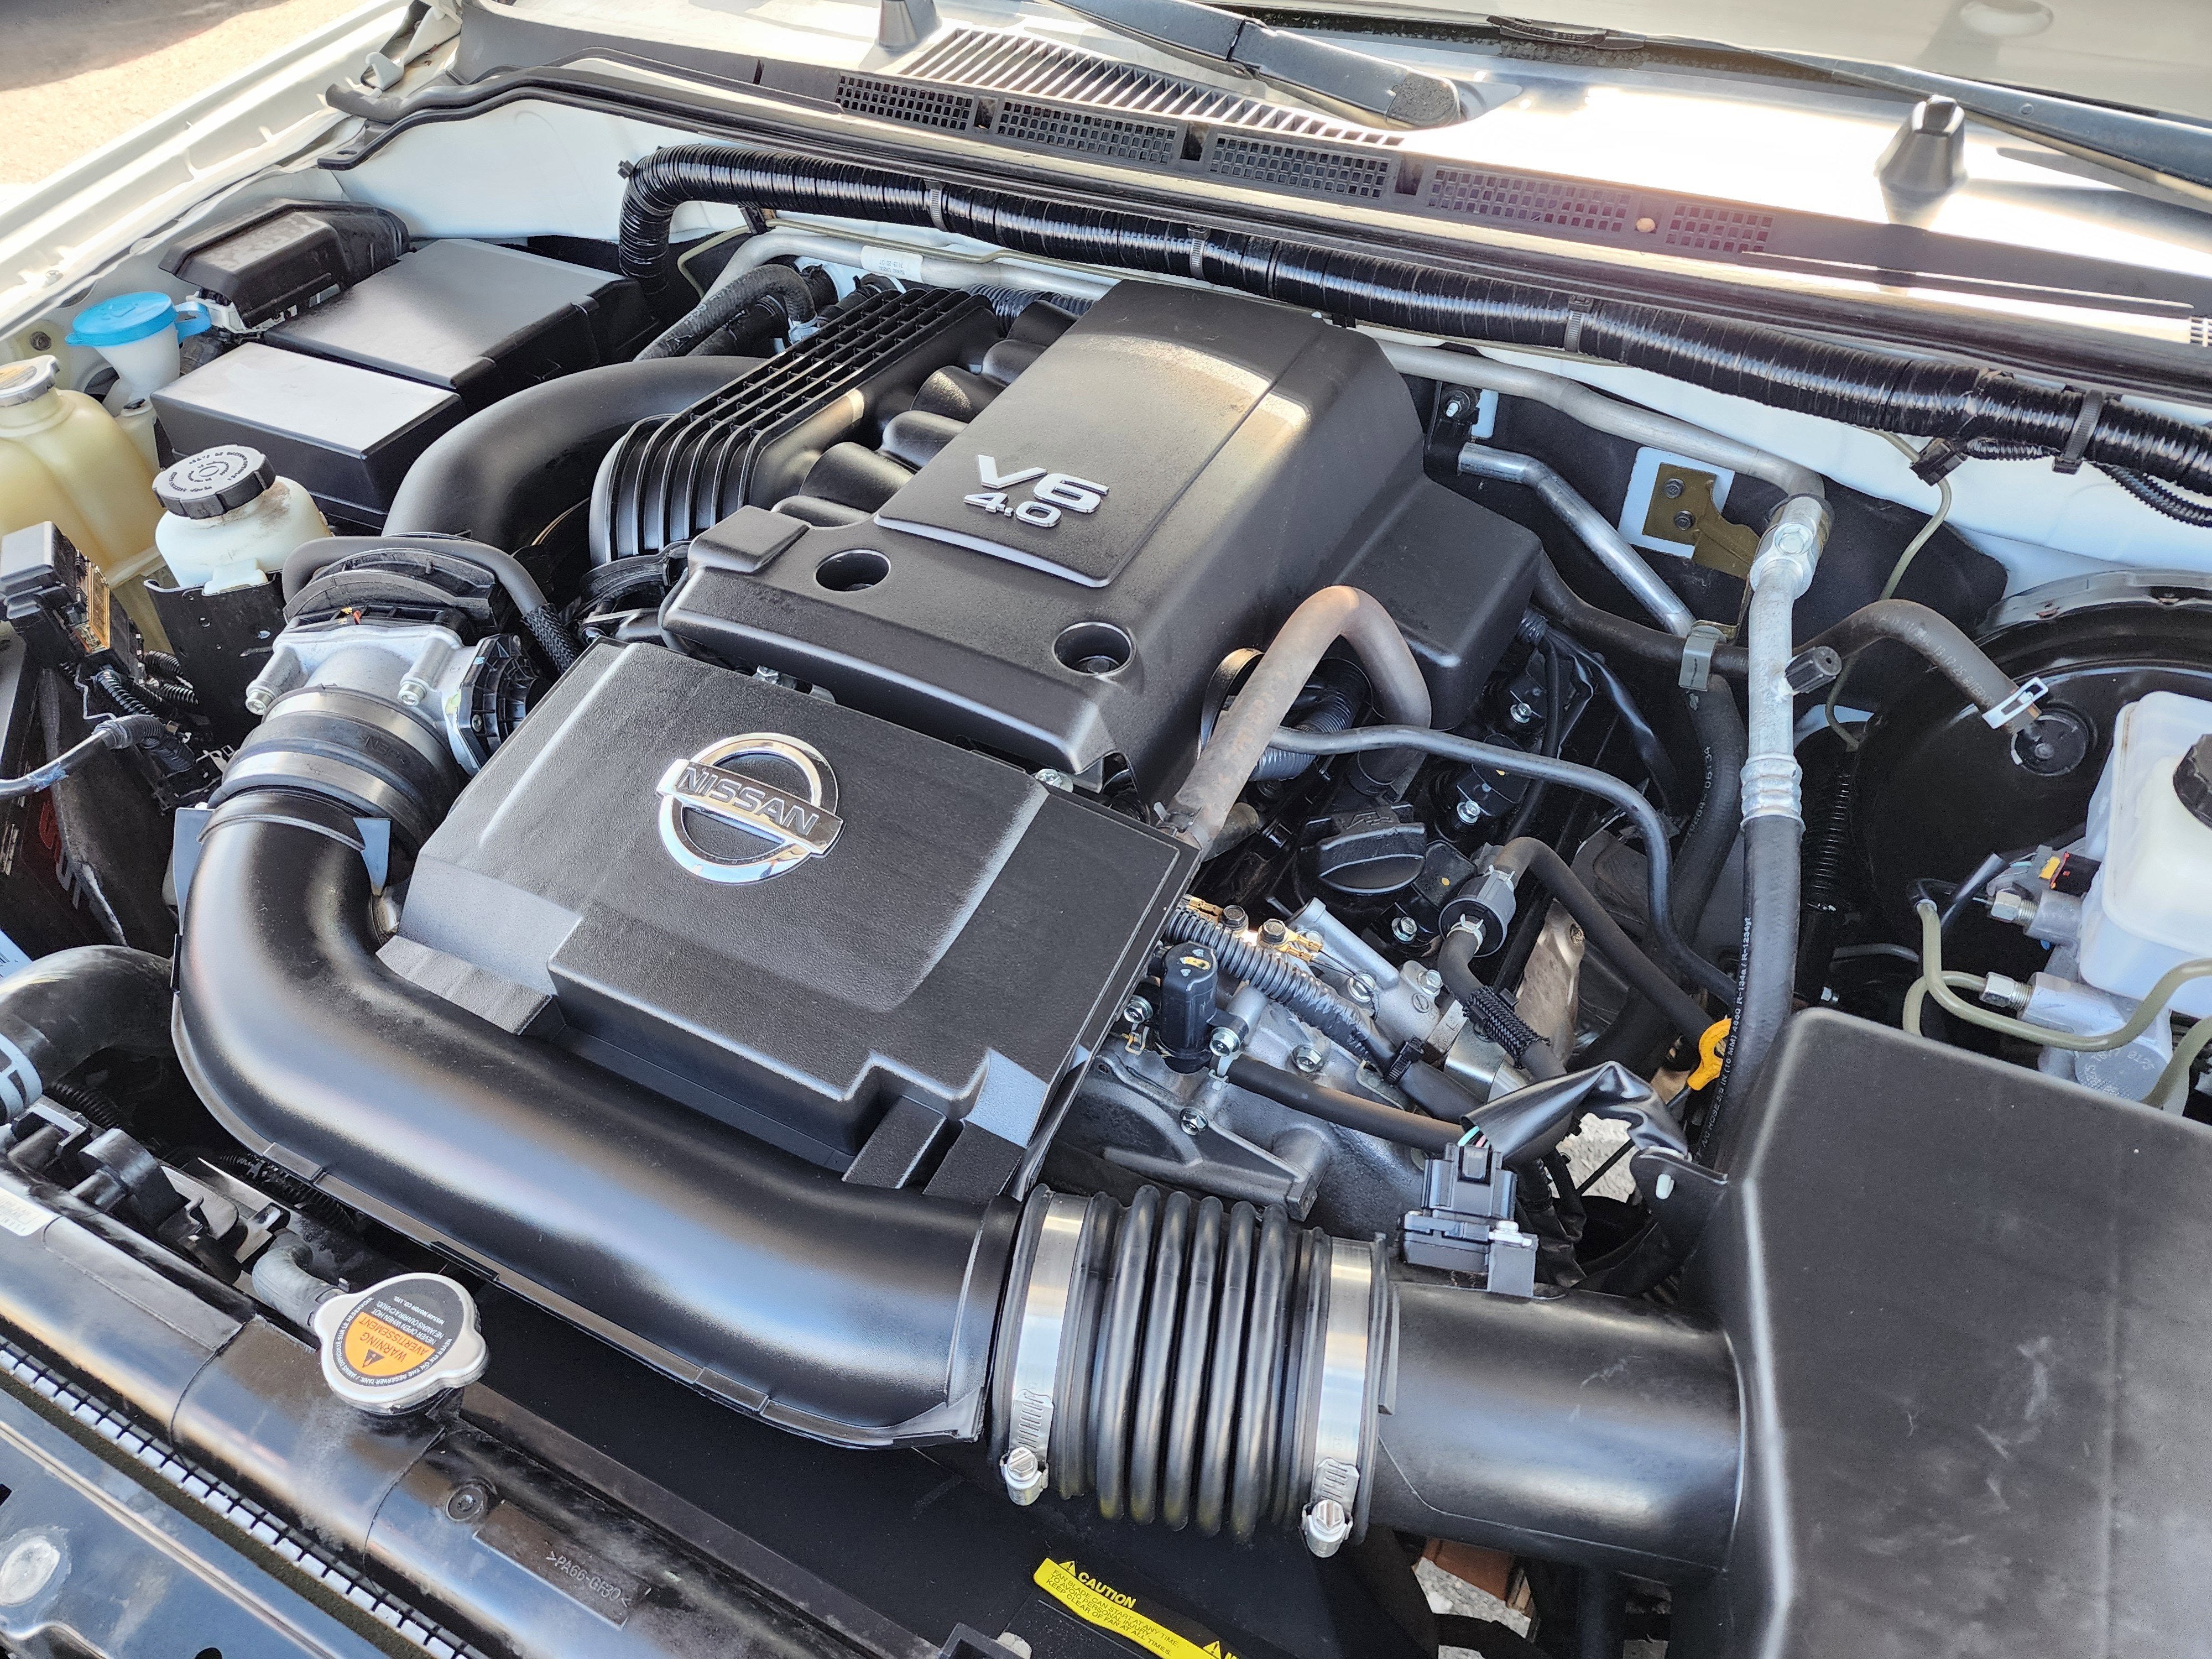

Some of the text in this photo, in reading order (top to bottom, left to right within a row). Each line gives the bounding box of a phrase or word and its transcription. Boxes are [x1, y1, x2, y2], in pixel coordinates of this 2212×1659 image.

[977, 455, 1110, 513] V6
[963, 492, 1062, 528] 4.0
[676, 766, 821, 837] NISSAN
[1706, 1102, 1720, 1130] HOSE
[1720, 1074, 1728, 1086] IN
[1728, 1035, 1738, 1055] MM)
[1735, 967, 1747, 1005] R-134a
[382, 1312, 402, 1327] WHEN
[398, 1311, 419, 1326] OUVRIR
[410, 1304, 428, 1317] MOTOR
[426, 1312, 445, 1326] NISSAN
[358, 1316, 429, 1356] AVERTISSEMENT
[359, 1331, 408, 1363] WARNING
[400, 1322, 418, 1336] OPEN
[416, 1331, 437, 1345] NEVER
[434, 1330, 444, 1339] NE
[1050, 1574, 1151, 1637] TO AVOID PERSONAL INJURY.
[1078, 1571, 1136, 1609] CAUTION
[1045, 1578, 1067, 1595] KEEP
[1065, 1594, 1091, 1614] CLEAR
[1091, 1611, 1103, 1620] OF
[1103, 1616, 1120, 1627] FAN
[1133, 1630, 1147, 1640] ALL
[1149, 1637, 1172, 1657] TIMES.
[1052, 1569, 1180, 1648] FAN BLADE CAN START AT ANY TIME.
